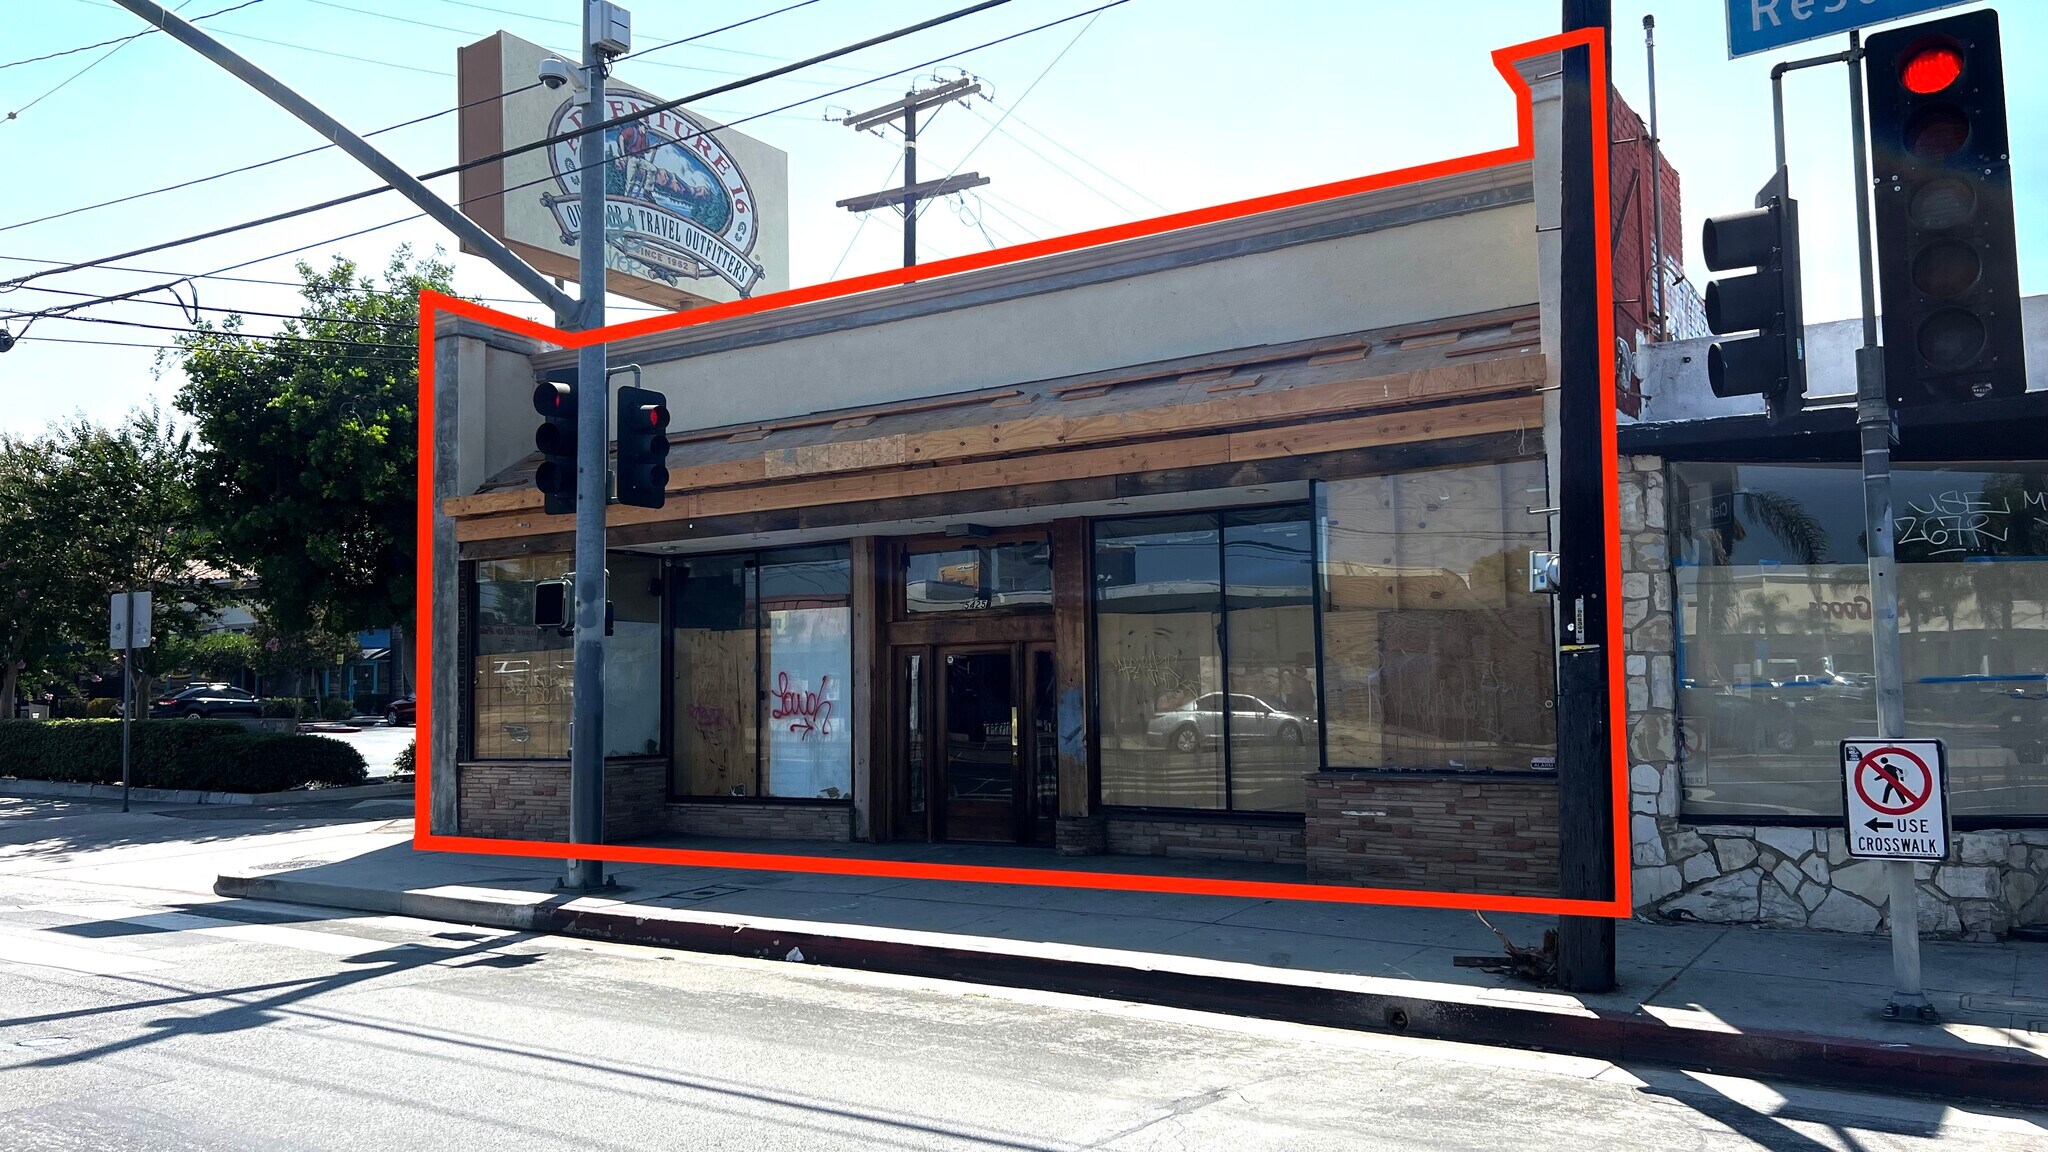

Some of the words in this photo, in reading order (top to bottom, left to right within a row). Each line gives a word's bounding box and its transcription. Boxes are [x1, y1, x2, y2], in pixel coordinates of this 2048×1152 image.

[729, 186, 751, 214] 16
[639, 209, 681, 243] TRAVEL
[685, 227, 748, 283] OUTFITTERS
[667, 256, 690, 271] 1962
[963, 599, 988, 611] 5425
[1897, 818, 1930, 834] USE
[1858, 836, 1938, 854] CROSSWALK
